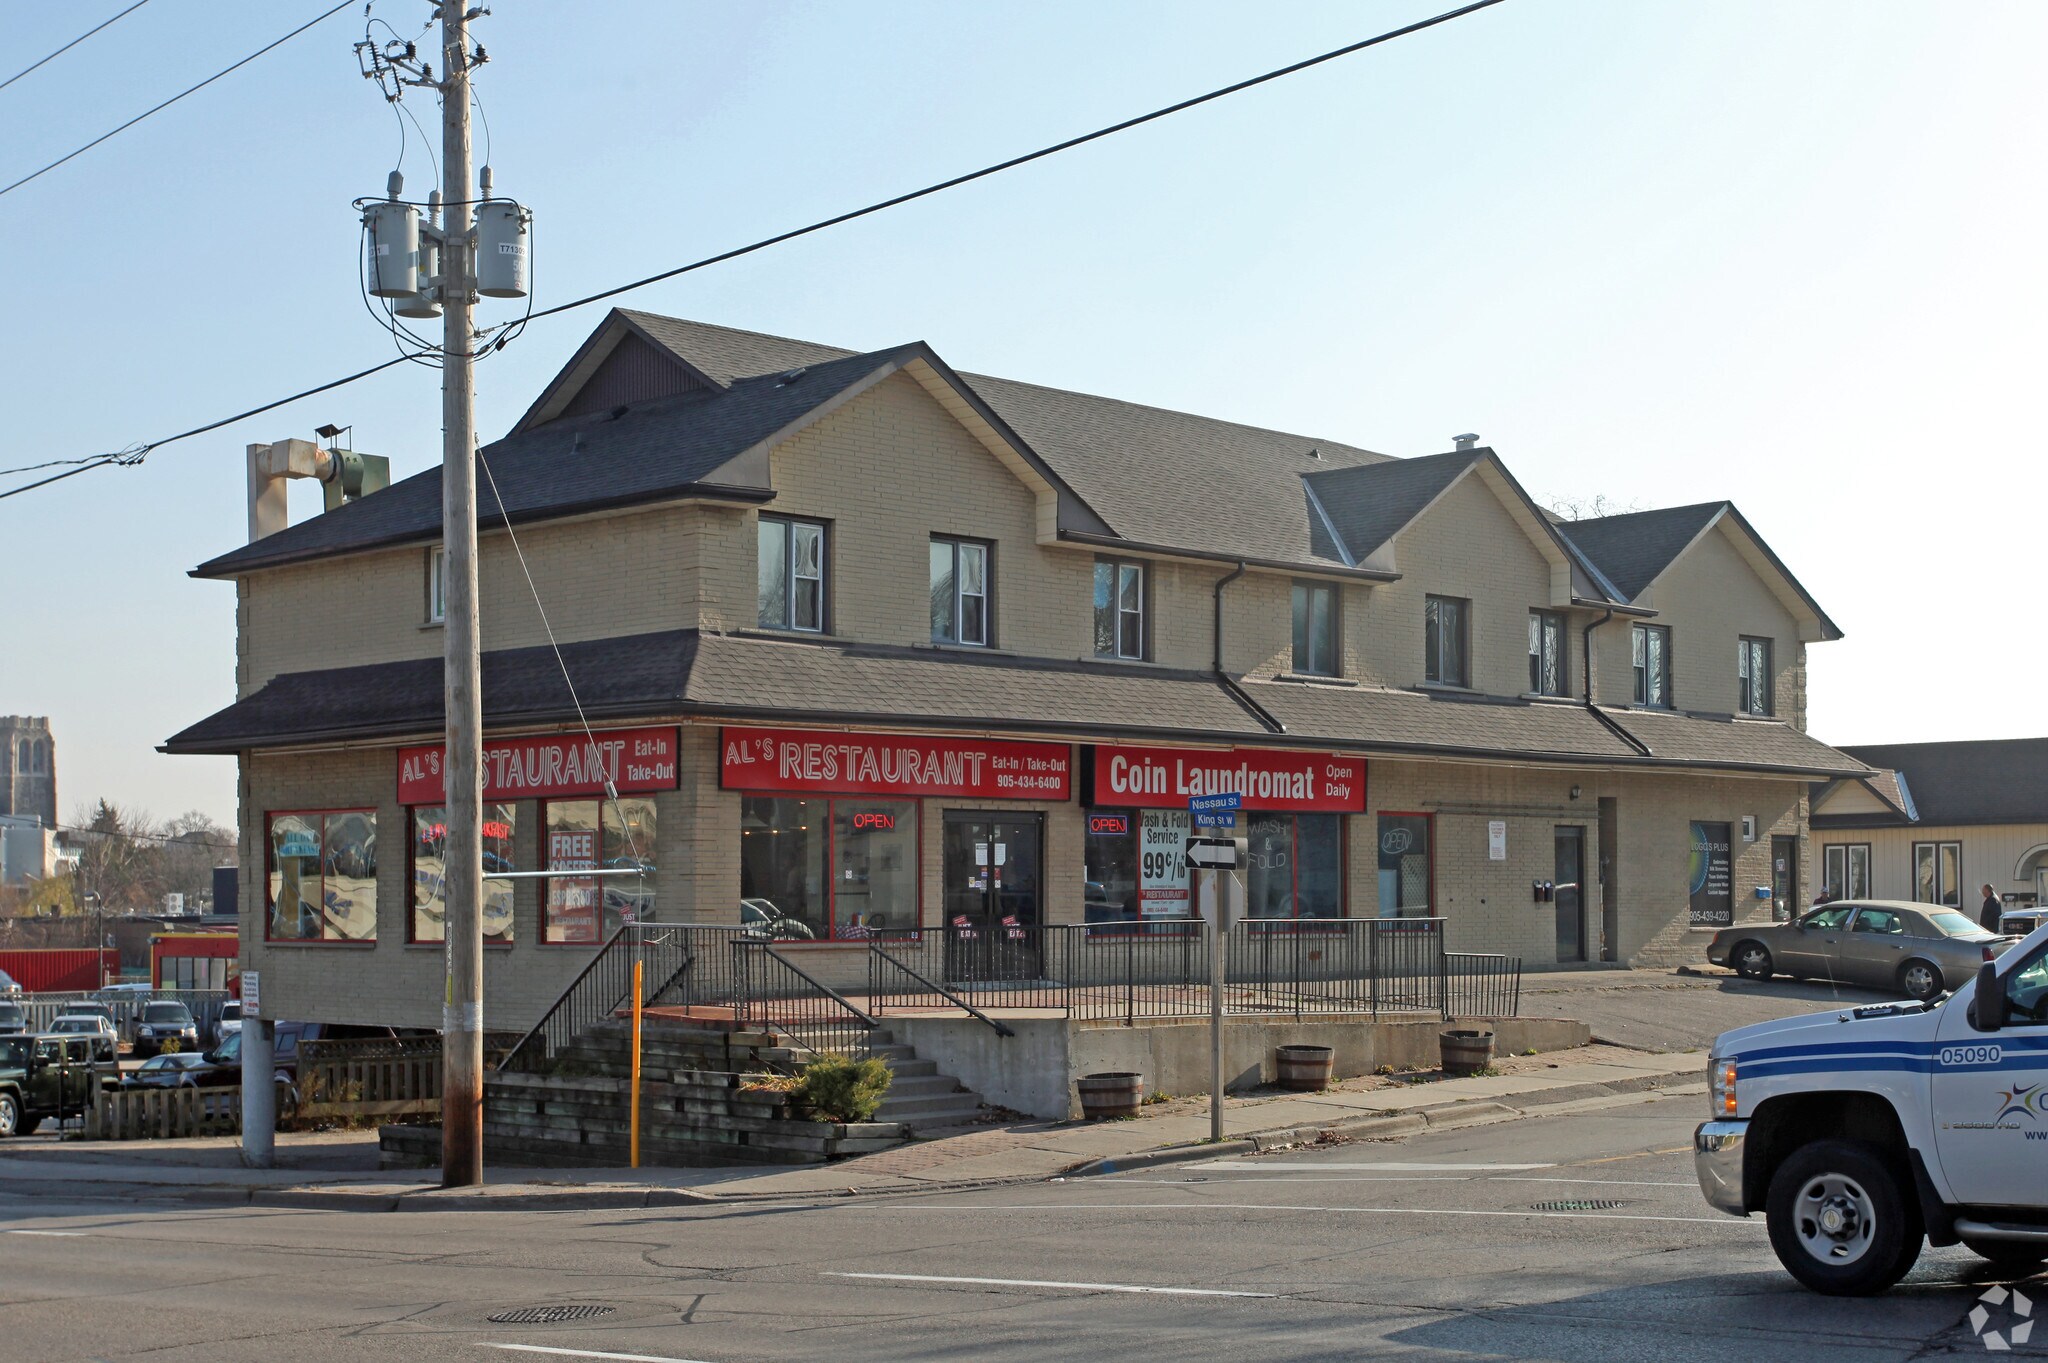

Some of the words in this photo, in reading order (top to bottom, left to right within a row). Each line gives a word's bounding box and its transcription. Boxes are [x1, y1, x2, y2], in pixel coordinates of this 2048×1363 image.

[634, 739, 667, 756] Eat-In
[402, 751, 440, 784] AL'S
[726, 738, 775, 766] AL'S
[780, 741, 986, 786] RESTAURANT
[992, 755, 1019, 769] Eat-In
[1027, 757, 1066, 772] Take-Out
[626, 763, 674, 781] Take-Out
[1110, 755, 1167, 794] Coin
[1176, 759, 1315, 799] Laundromat
[1326, 764, 1352, 779] Open
[997, 774, 1061, 789] 905-434-6400
[1326, 783, 1351, 800] Daily
[1192, 799, 1227, 810] Nassau
[1228, 797, 1238, 806] St
[854, 813, 895, 829] OPEN
[1091, 818, 1127, 832] OPEN
[1162, 811, 1169, 828] &
[1171, 812, 1188, 828] Fold
[1197, 814, 1215, 827] King
[1226, 816, 1233, 825] W
[1248, 820, 1287, 836] WASH
[1147, 827, 1179, 845] Service
[1382, 829, 1412, 851] OPEN
[551, 835, 592, 857] FREE
[1714, 843, 1729, 852] PLUS
[1248, 852, 1287, 869] FOLD
[623, 913, 636, 921] JUST
[1941, 1046, 2001, 1064] 05090
